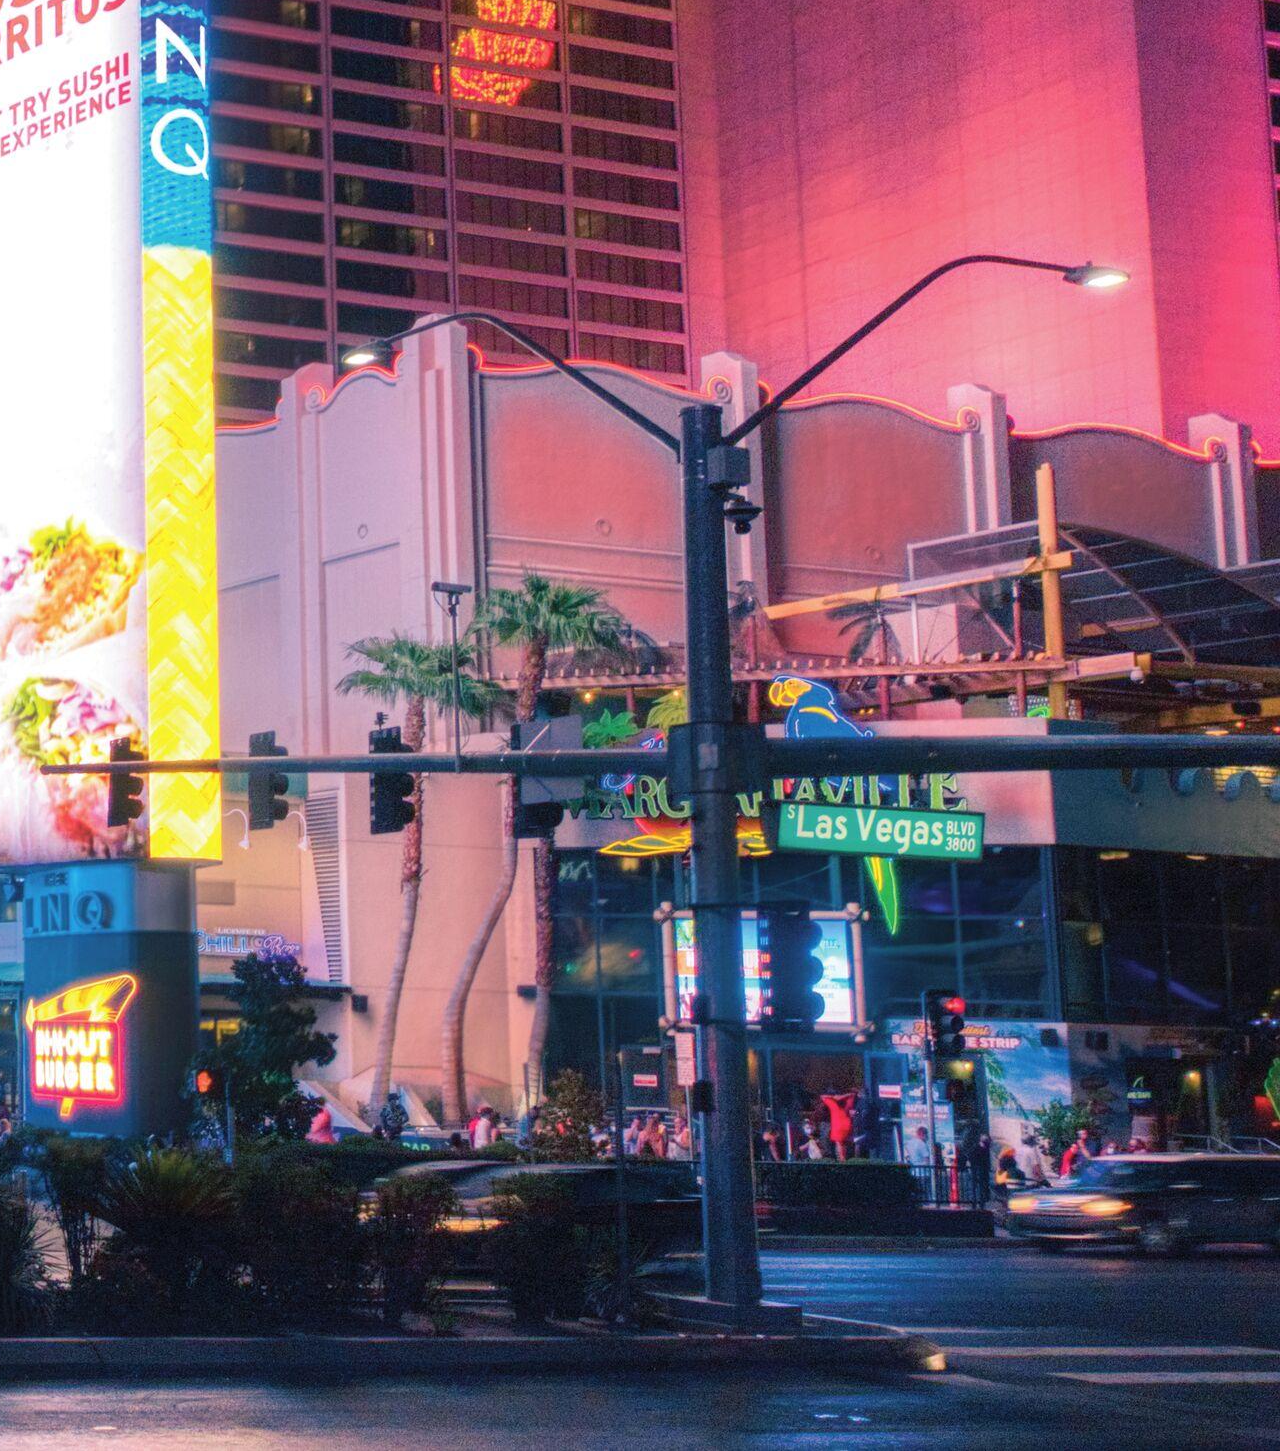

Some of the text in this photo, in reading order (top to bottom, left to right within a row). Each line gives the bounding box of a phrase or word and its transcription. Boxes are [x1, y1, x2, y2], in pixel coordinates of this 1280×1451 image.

[8, 88, 51, 131] TRY
[58, 52, 130, 105] SUSHI
[0, 81, 133, 158] EXPERIENCE
[787, 803, 977, 856] S Las Vegas BLVD
[945, 836, 977, 853] 3800
[891, 1034, 923, 1047] BAR
[980, 1036, 1022, 1050] STRIP
[34, 1060, 116, 1092] BURGER
